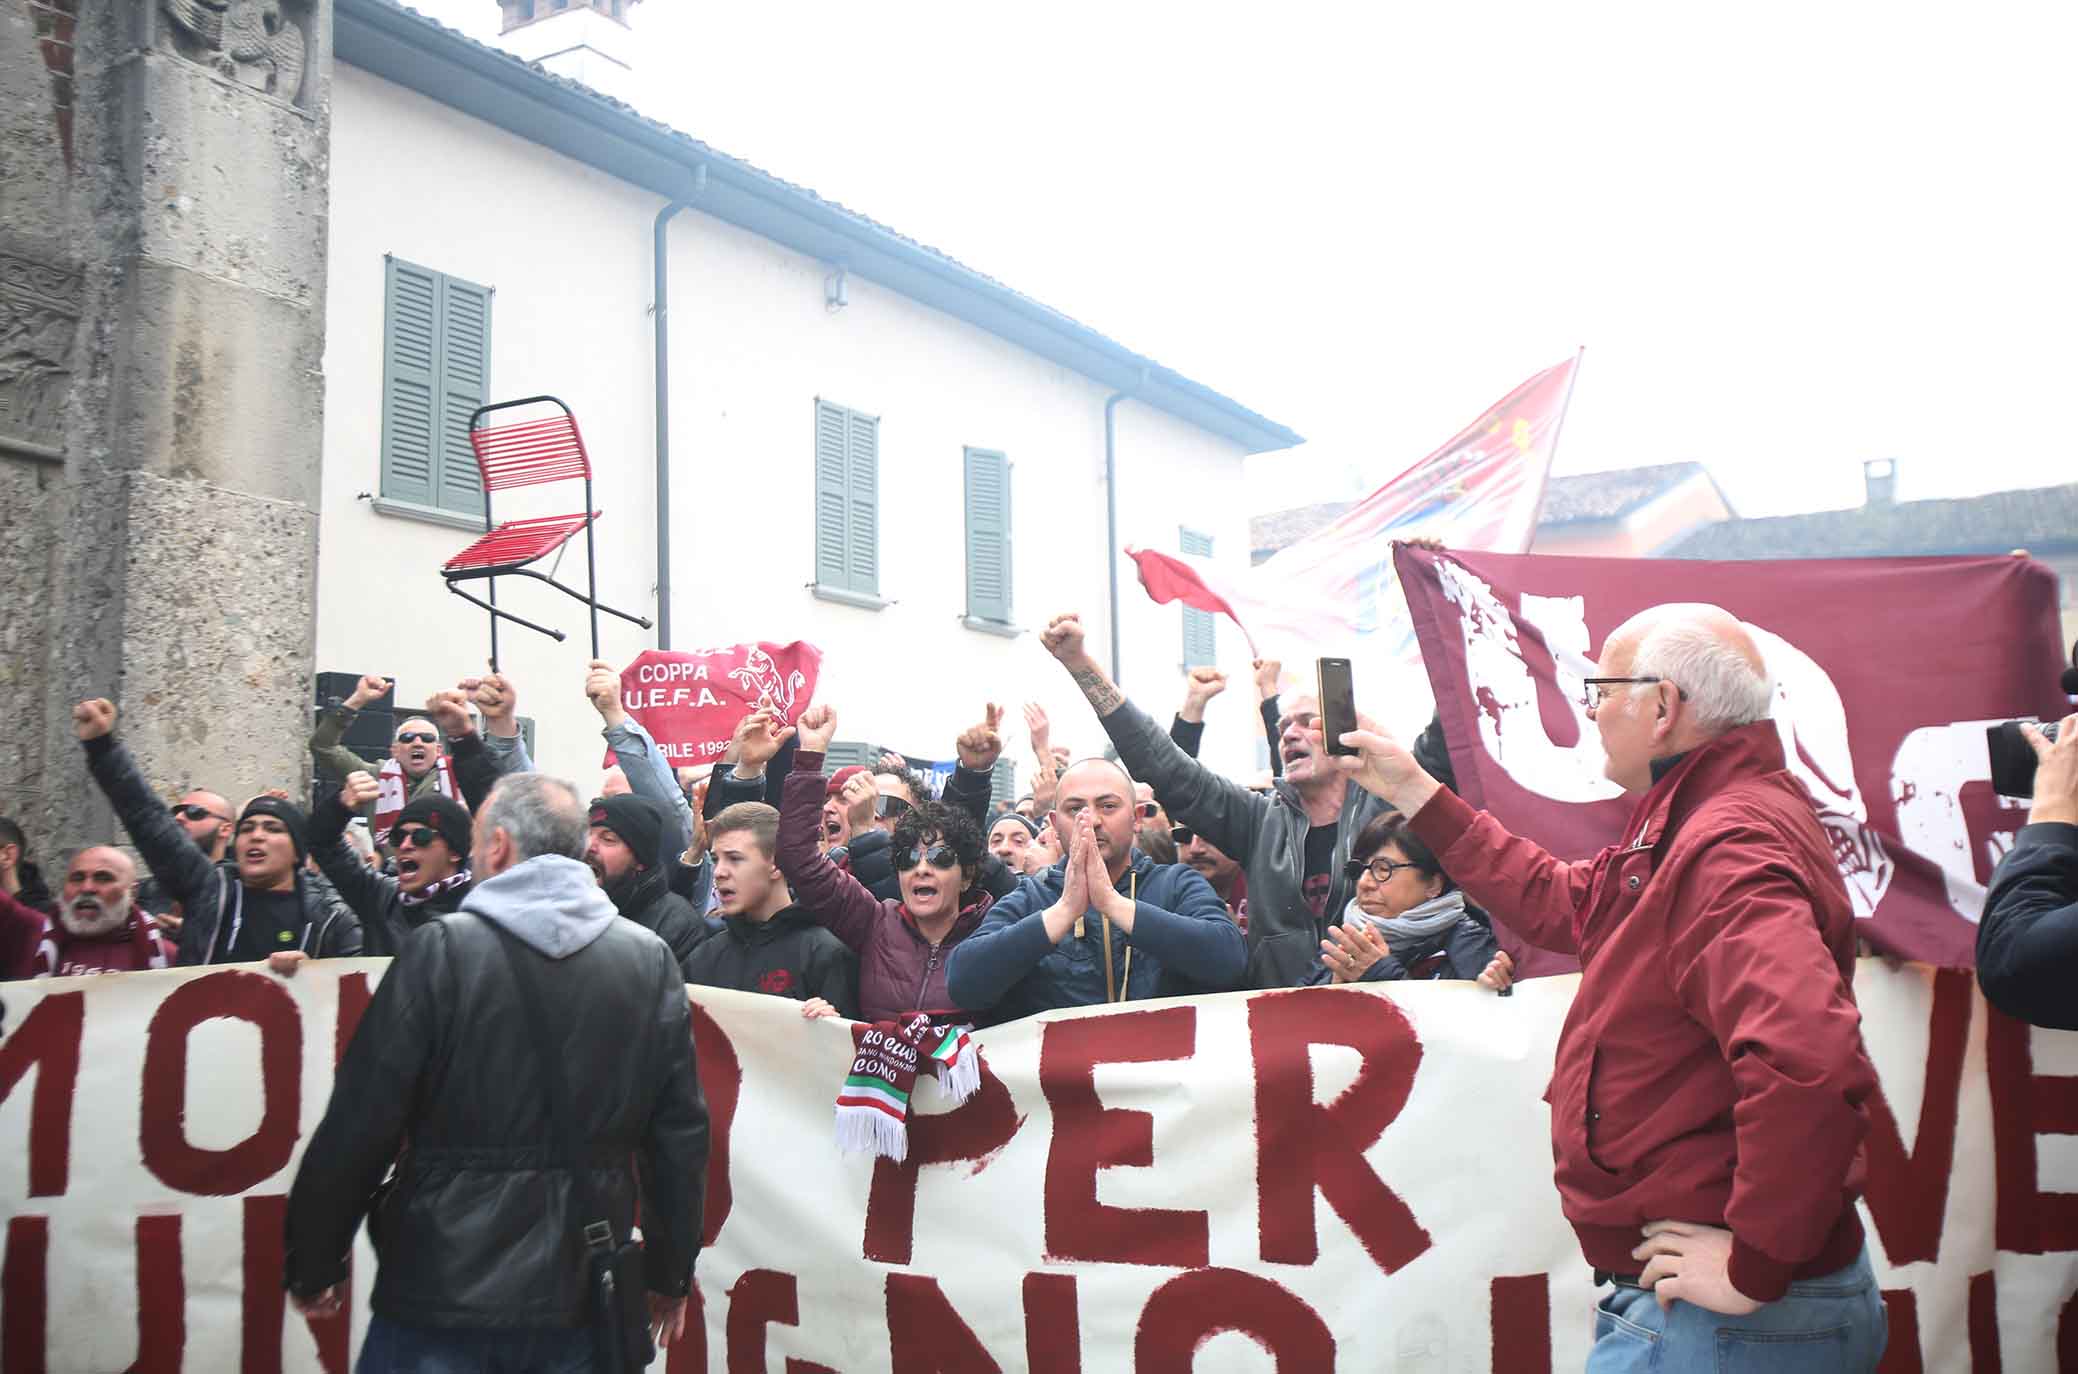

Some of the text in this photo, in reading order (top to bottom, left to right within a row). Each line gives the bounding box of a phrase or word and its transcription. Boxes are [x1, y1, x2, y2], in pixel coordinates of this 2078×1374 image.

[640, 663, 709, 683] COPPA
[625, 687, 727, 710] U.E.F.A.
[698, 740, 732, 756] 1992
[903, 1013, 931, 1038] TOR
[884, 1037, 917, 1063] CLUB
[853, 1058, 897, 1083] COMO
[862, 987, 1435, 1276] PER
